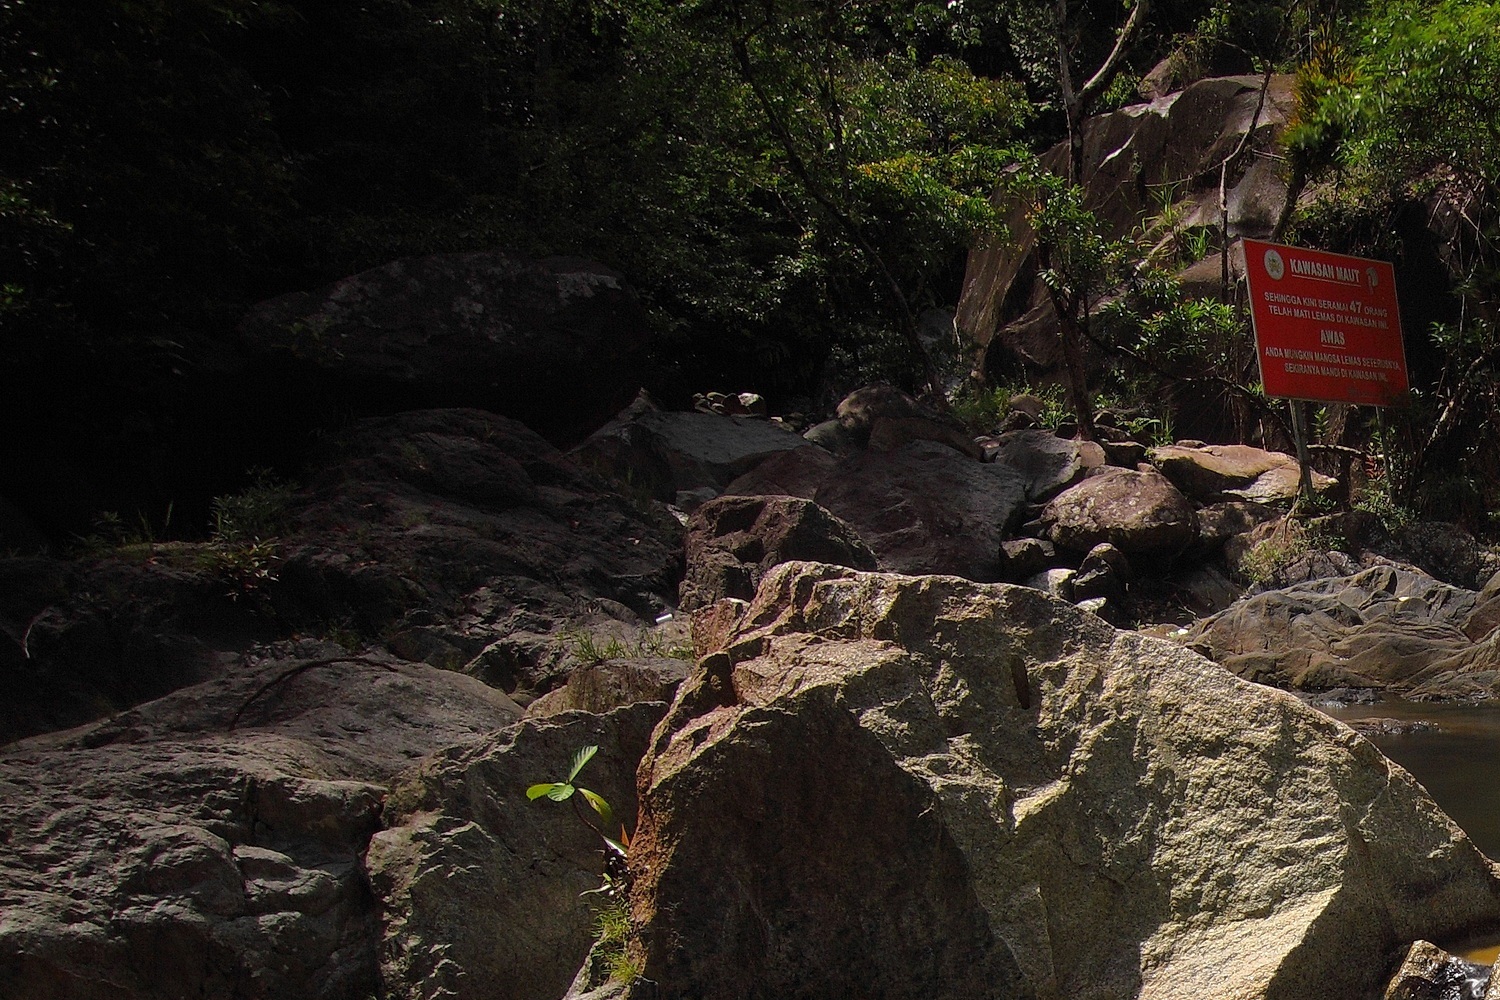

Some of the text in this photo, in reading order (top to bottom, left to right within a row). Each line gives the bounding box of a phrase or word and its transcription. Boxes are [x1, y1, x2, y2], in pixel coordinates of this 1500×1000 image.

[1289, 258, 1360, 283] KAWASAN MAUT
[1264, 291, 1388, 318] SEHINGGA KINI SERAMAI 47 ORANG
[1268, 304, 1293, 316] TELAH
[1293, 308, 1311, 319] MATI
[1311, 310, 1336, 322] LEMAS
[1336, 314, 1344, 323] DI
[1344, 315, 1378, 328] KAWASAN
[1320, 329, 1346, 346] AWAS
[1265, 346, 1284, 358] ANDA
[1284, 348, 1314, 361] MUNGKIN
[1314, 351, 1340, 364] MANGSA
[1340, 354, 1361, 367] LEMAS
